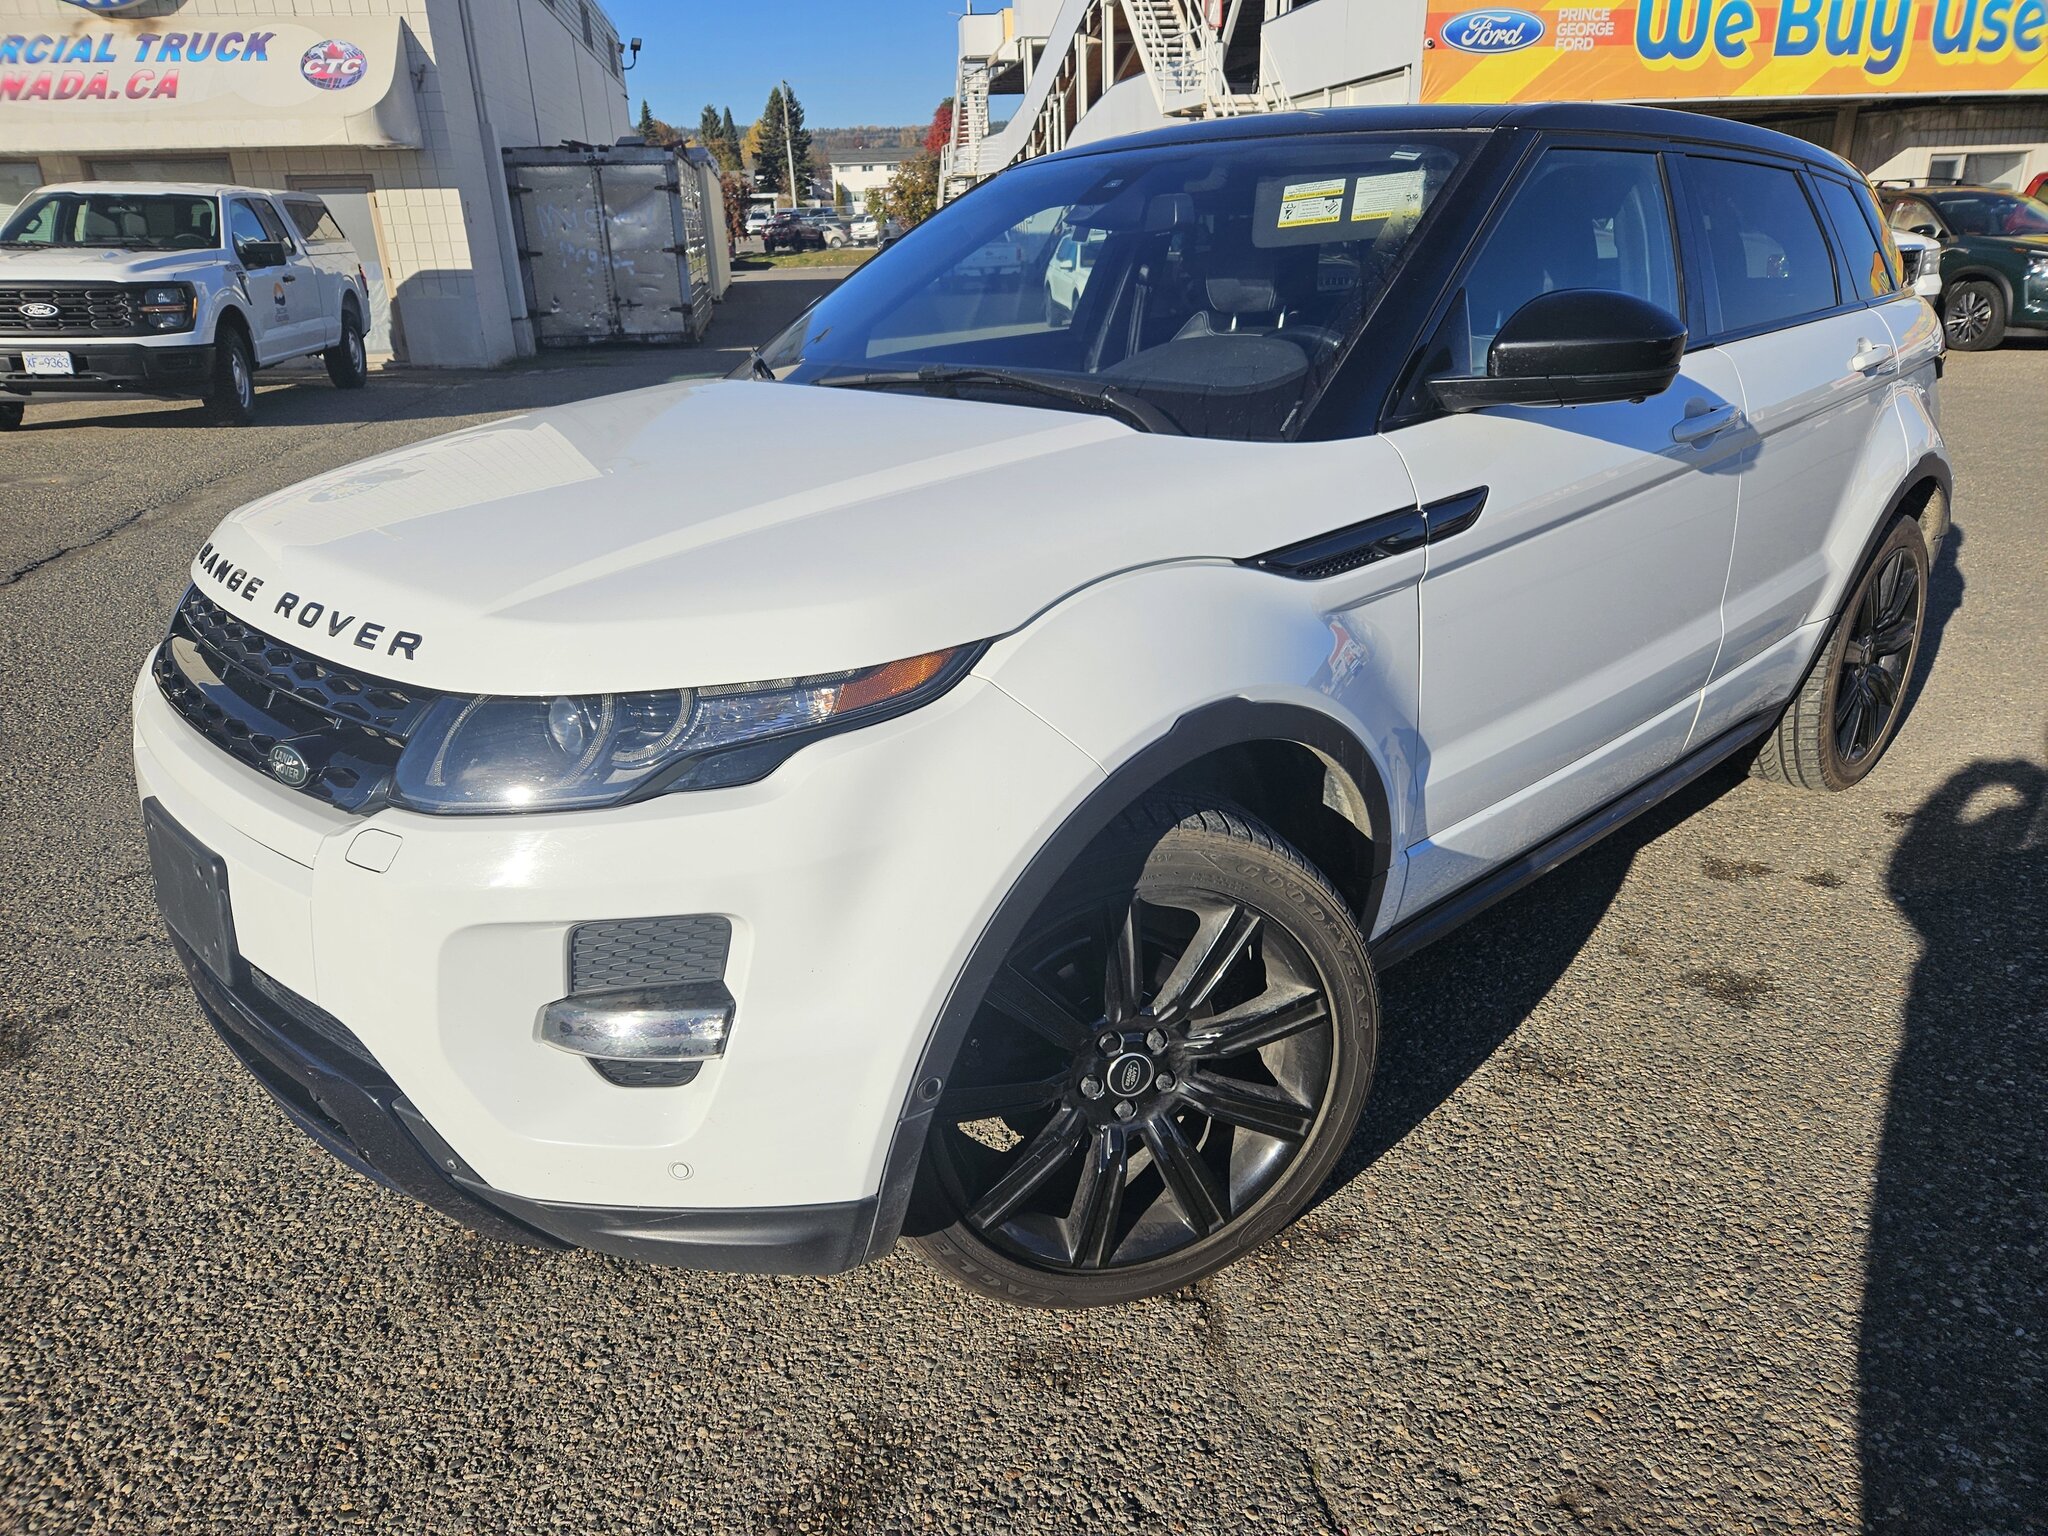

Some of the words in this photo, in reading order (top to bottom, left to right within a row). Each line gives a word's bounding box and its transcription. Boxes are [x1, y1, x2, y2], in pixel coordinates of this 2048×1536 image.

[1558, 8, 1611, 21] PRINCE
[1460, 14, 1526, 46] Ford
[1556, 22, 1615, 36] GEORGE
[1635, 0, 1755, 60] We
[1773, 0, 1913, 75] Buy
[134, 32, 276, 62] TRUCK
[1554, 37, 1594, 51] FORD
[303, 58, 362, 75] CTC
[0, 69, 180, 101] NADA.CA
[198, 542, 265, 602] RANGE
[273, 591, 424, 661] ROVER
[274, 749, 293, 765] LAND
[275, 762, 299, 780] ROVER
